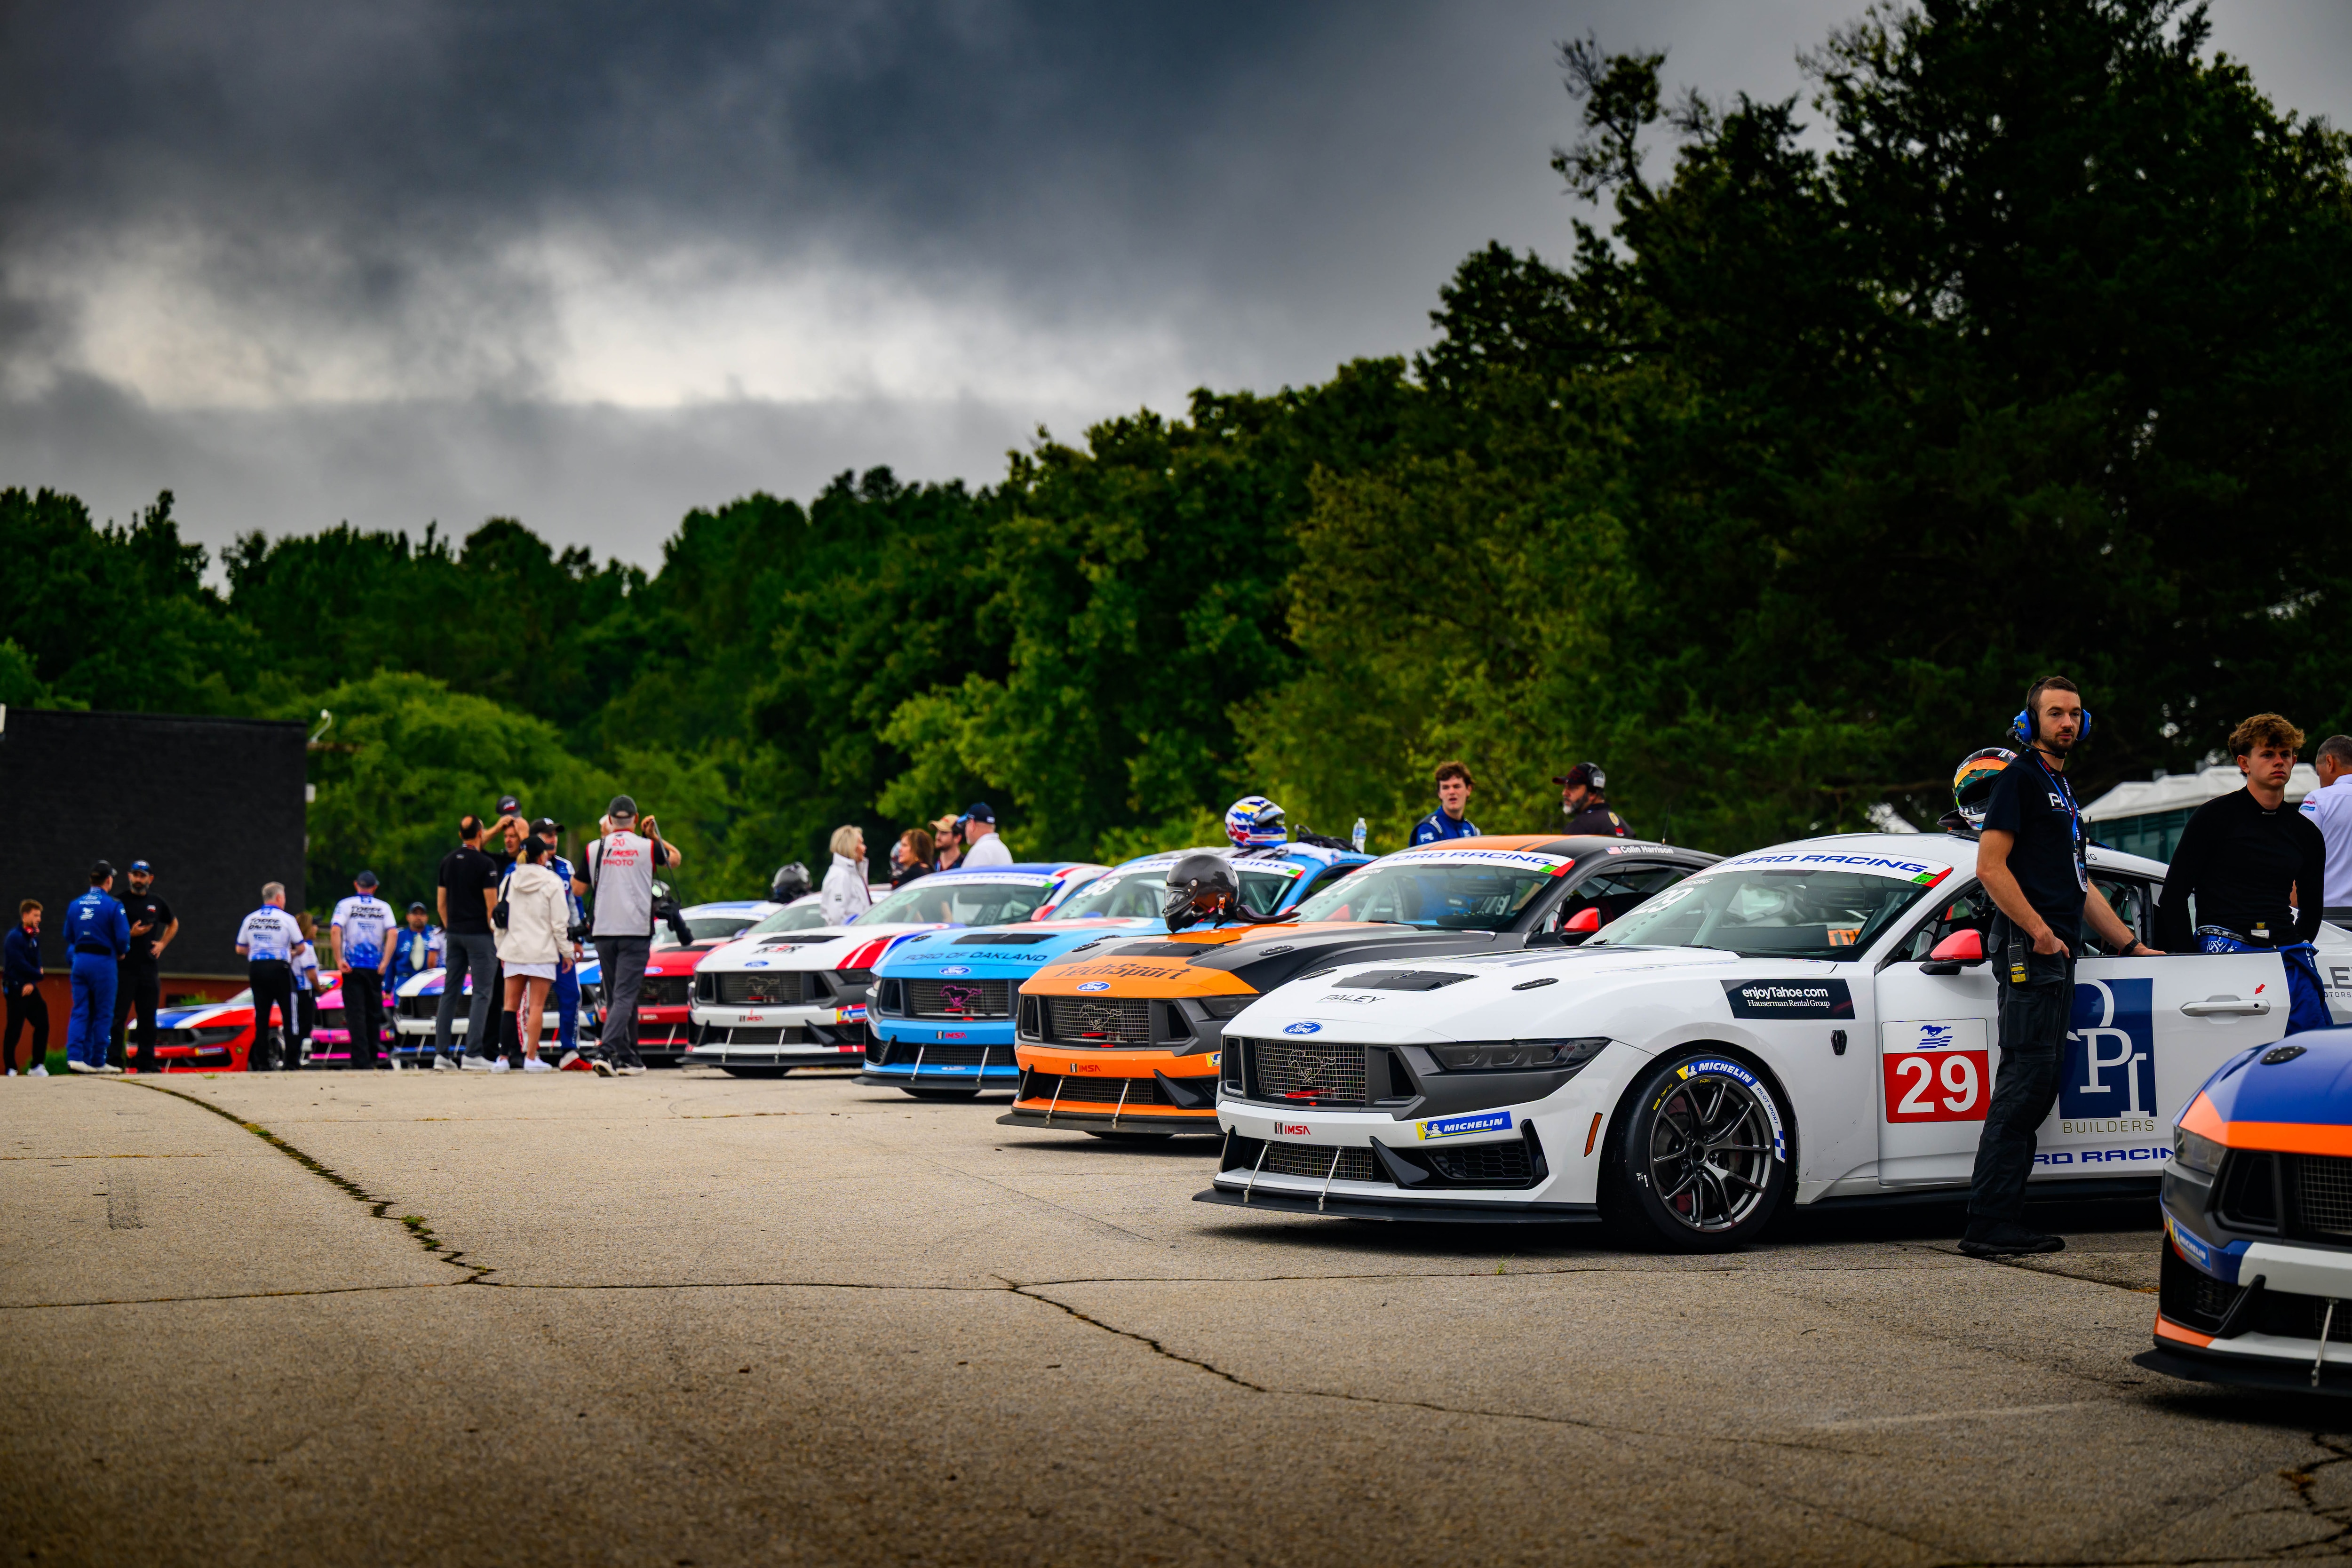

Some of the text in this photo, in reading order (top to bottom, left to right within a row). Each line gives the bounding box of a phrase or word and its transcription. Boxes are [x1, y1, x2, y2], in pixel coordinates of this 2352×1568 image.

[612, 838, 625, 847] 20
[1377, 853, 1446, 864] FORD
[1449, 852, 1553, 865] RACING
[1715, 855, 1929, 873] FORD RACING
[1629, 887, 1694, 916] 29
[969, 952, 1048, 961] OAKLAND
[1319, 995, 1386, 1003] PALEY
[1742, 987, 1828, 999] enjoyTahoe.com
[1810, 1000, 1830, 1008] Group
[1079, 1064, 1101, 1073] IMSA
[1698, 1062, 1753, 1083] MICHELIN
[1896, 1055, 1979, 1114] 29
[1756, 1087, 1779, 1125] PILOT SPORT
[1285, 1125, 1311, 1135] IMSA
[1444, 1118, 1503, 1132] MICHELIN
[2063, 1119, 2154, 1133] BUILDERS
[2034, 1147, 2174, 1165] RD RACIN
[2179, 1235, 2206, 1260] MICHELIN
